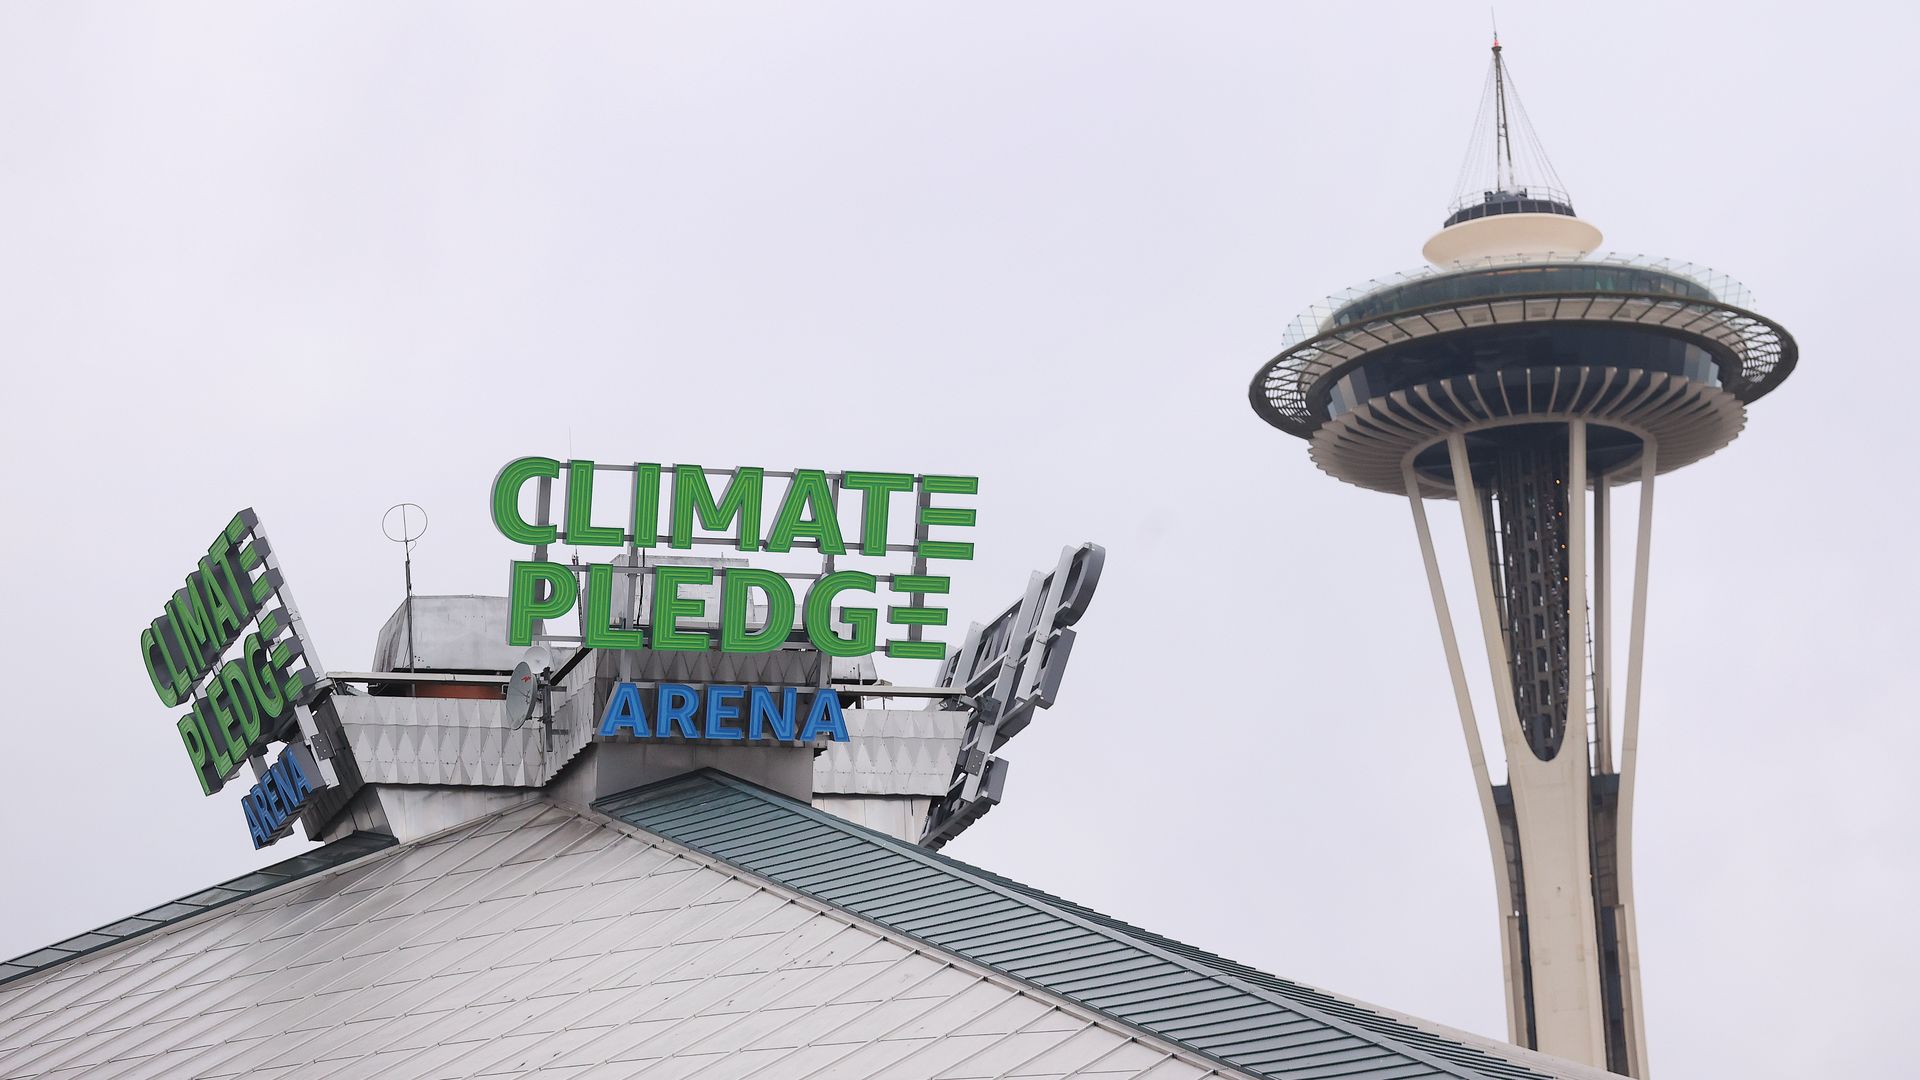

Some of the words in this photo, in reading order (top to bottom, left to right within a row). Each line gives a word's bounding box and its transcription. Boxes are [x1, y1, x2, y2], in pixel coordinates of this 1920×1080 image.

[492, 456, 979, 561] CLIMATE
[141, 508, 278, 708] CLIMATE
[509, 560, 951, 660] PLEDGE
[177, 610, 309, 796] PLEDGE
[600, 682, 850, 743] ARENA
[241, 745, 314, 850] ARENA
